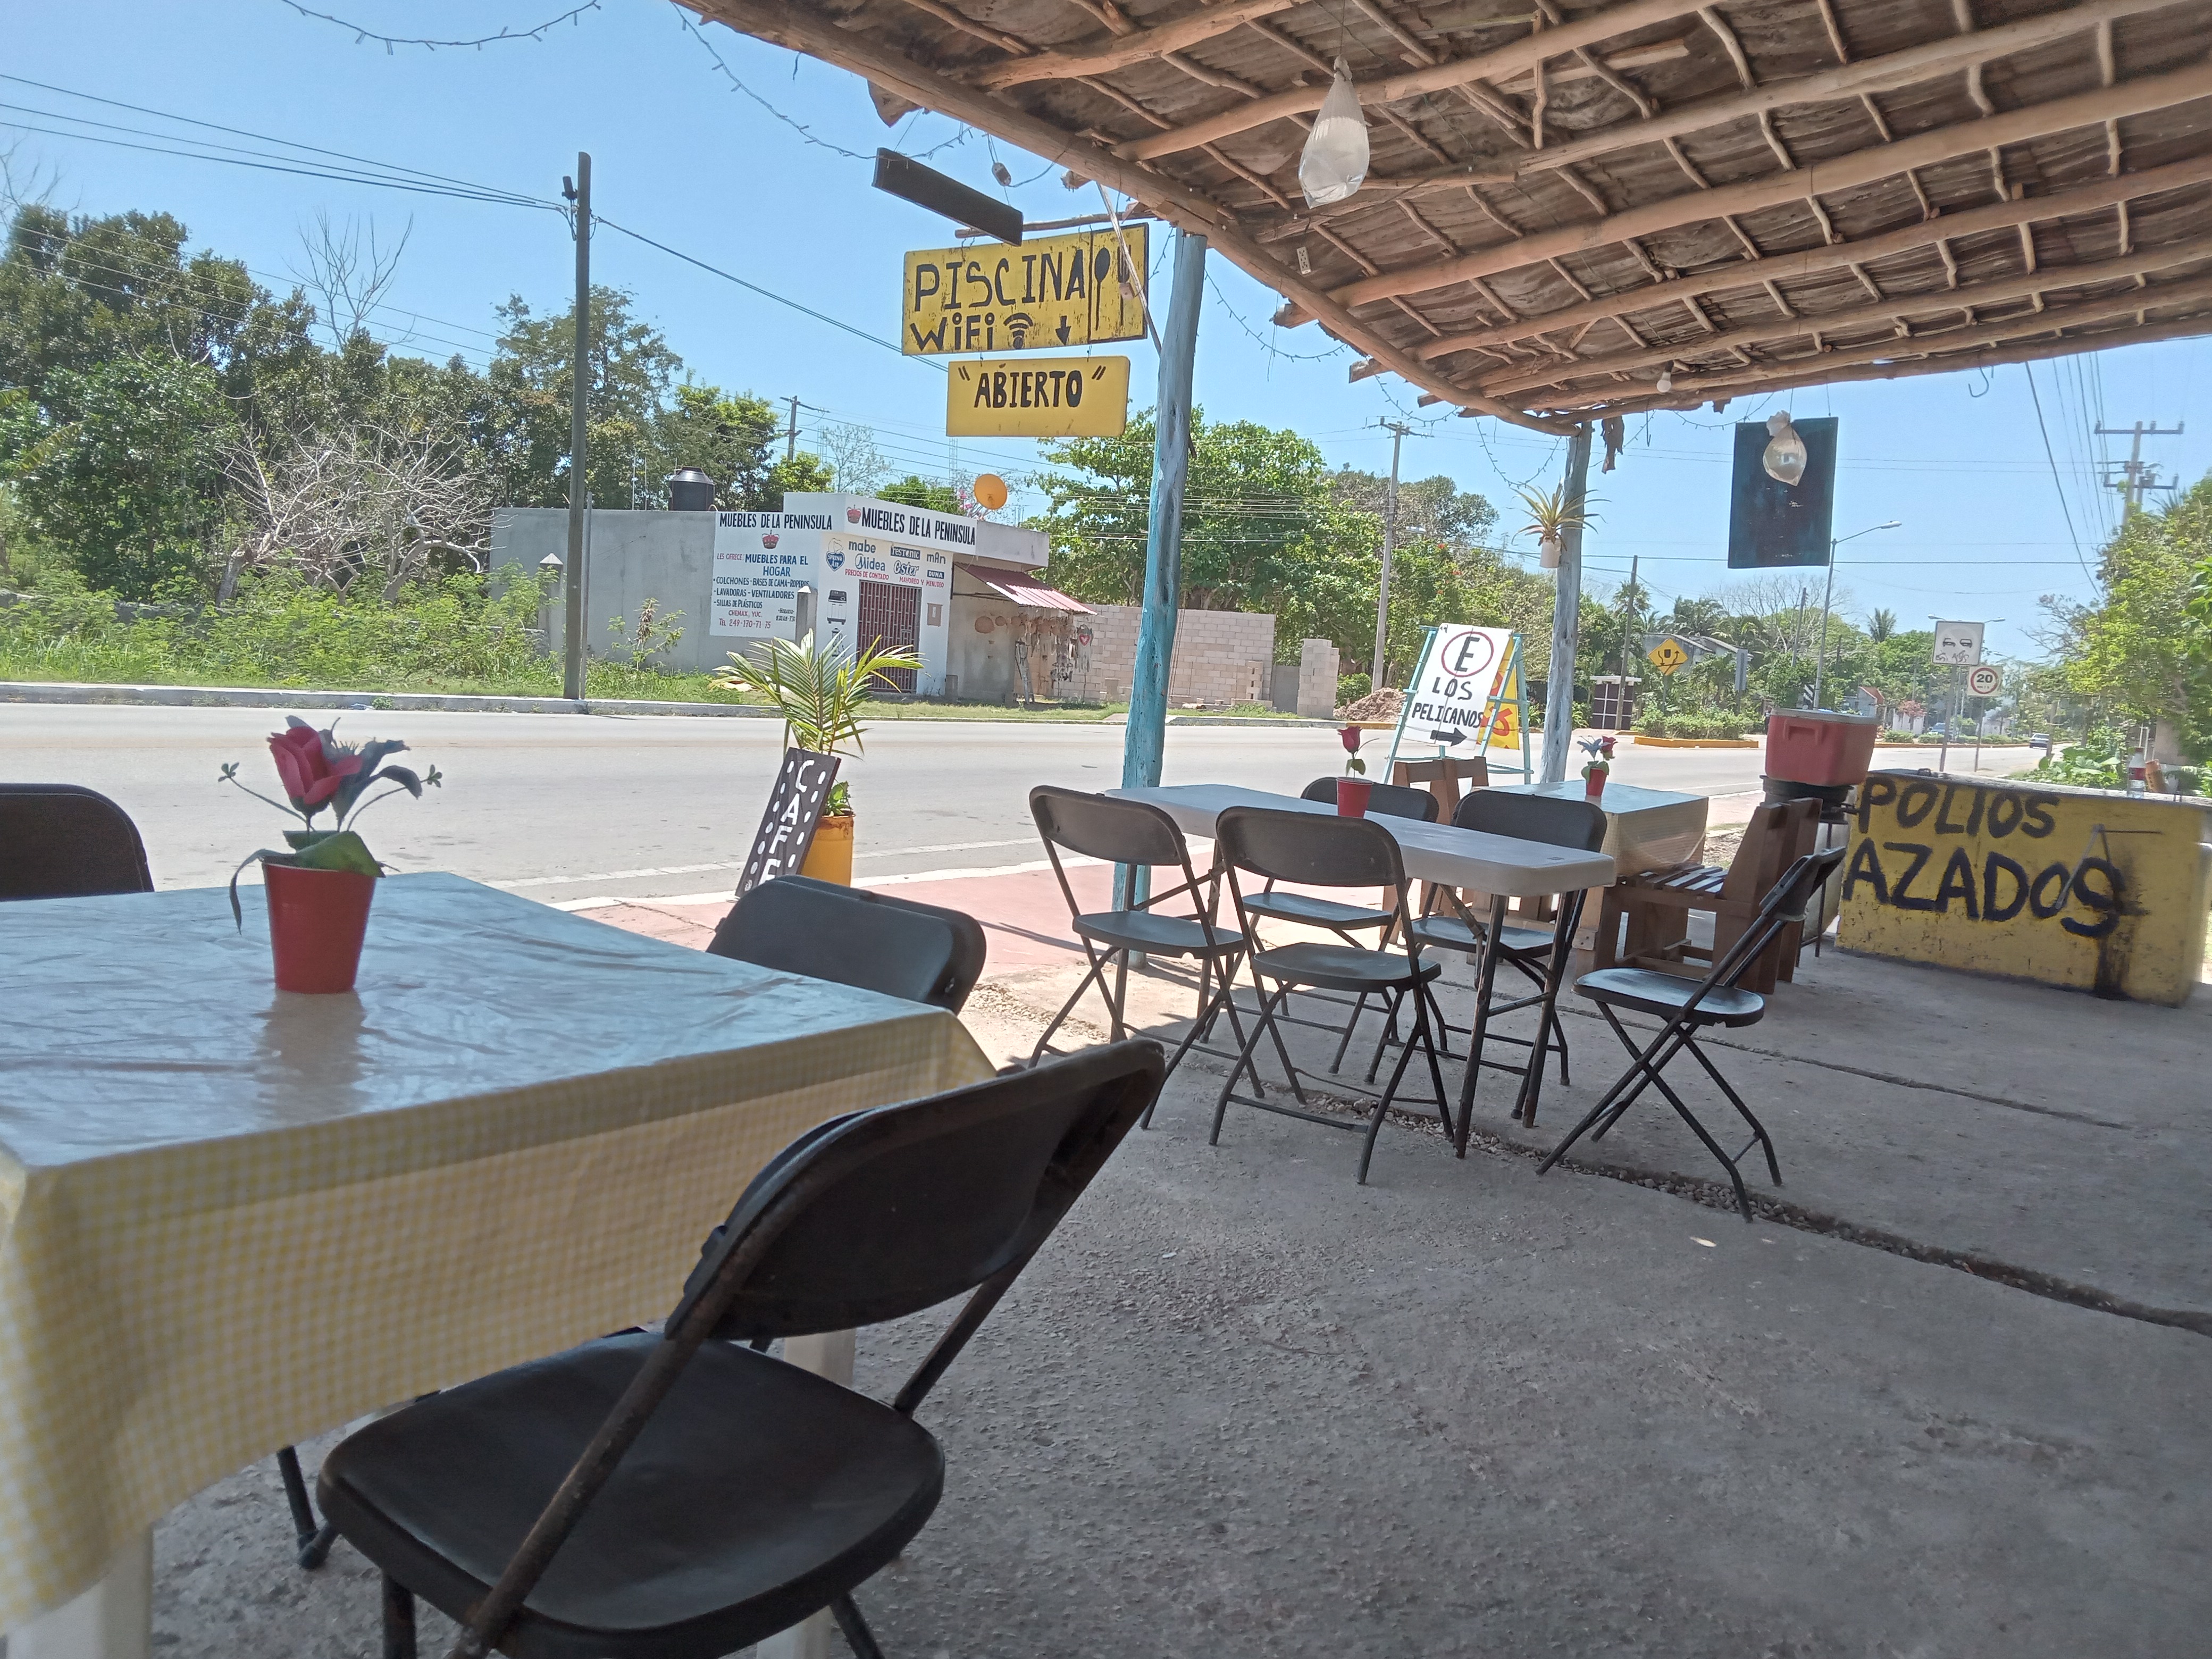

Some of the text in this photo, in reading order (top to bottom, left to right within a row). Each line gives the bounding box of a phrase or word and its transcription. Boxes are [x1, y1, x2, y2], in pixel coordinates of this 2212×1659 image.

[914, 249, 1085, 312] PISCINA
[719, 513, 757, 527] MUEBLES
[784, 515, 832, 530] PENINSULA
[862, 507, 904, 533] MUEBLES
[934, 520, 976, 546] PENINSULA
[849, 539, 876, 553] mabe
[745, 554, 809, 565] MUEBLES PARA EL
[855, 553, 885, 571] Midea
[763, 566, 791, 577] HOGAR
[845, 568, 862, 577] PRECIOS
[894, 560, 919, 576] Oster
[927, 570, 944, 579] DUNA
[729, 619, 761, 628] 249-170-71
[1454, 636, 1480, 672] E
[1976, 674, 1993, 683] 20
[1432, 676, 1472, 700] LOS
[1412, 702, 1484, 728] PELICANOS
[1844, 837, 2127, 939] AZADOS
